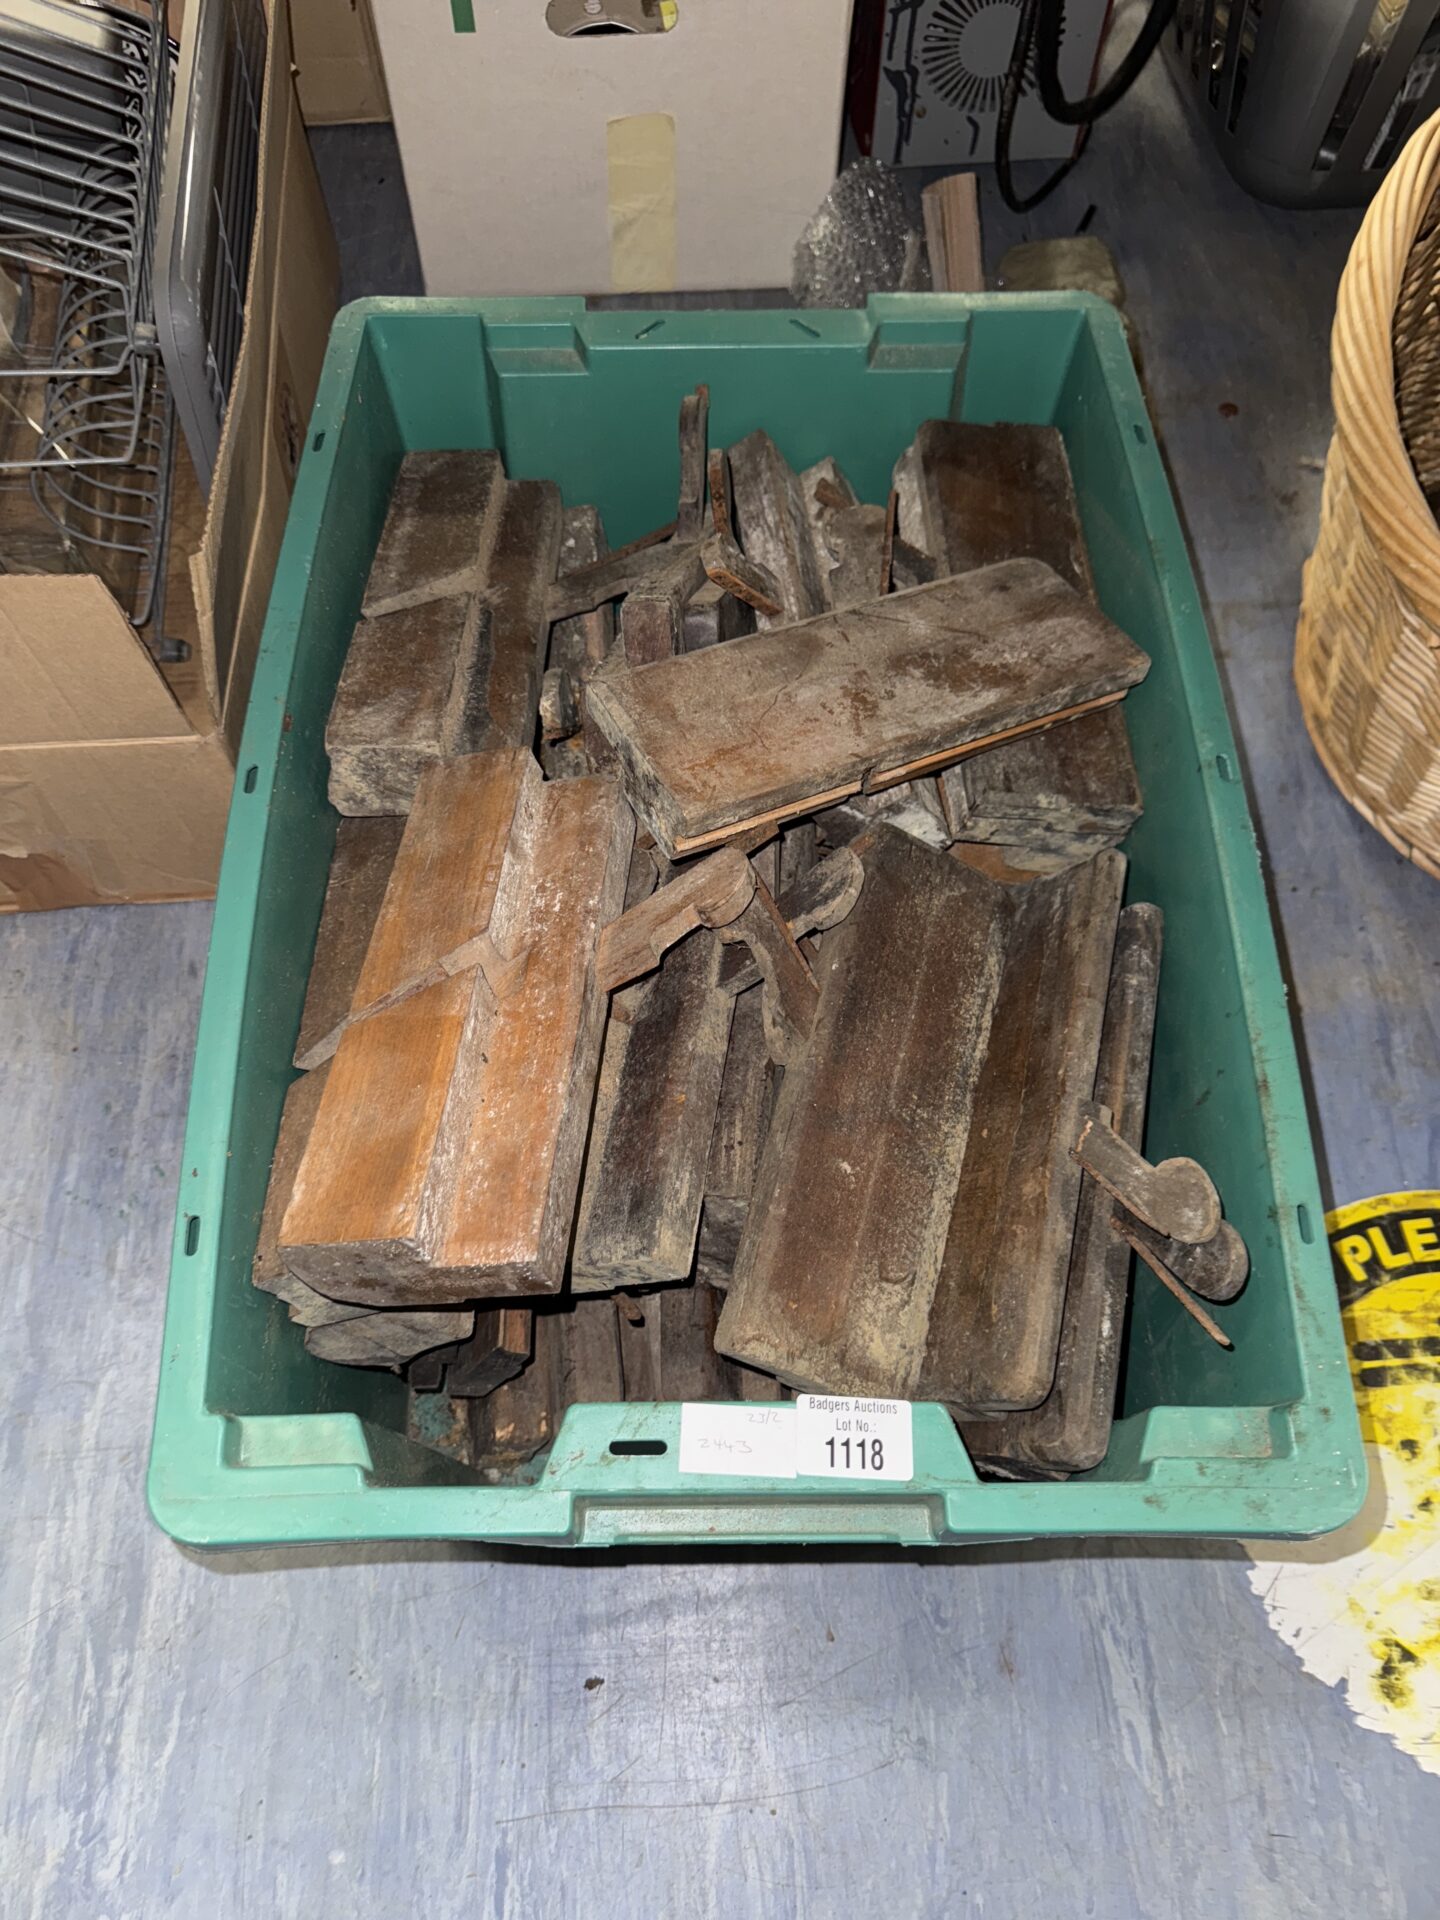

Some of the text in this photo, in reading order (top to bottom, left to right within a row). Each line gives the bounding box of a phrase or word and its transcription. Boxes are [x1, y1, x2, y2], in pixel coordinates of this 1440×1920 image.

[809, 1397, 898, 1414] Badgers Auctions
[836, 1419, 877, 1432] Lot No.:
[698, 1438, 752, 1453] 2443
[825, 1436, 884, 1471] 1118
